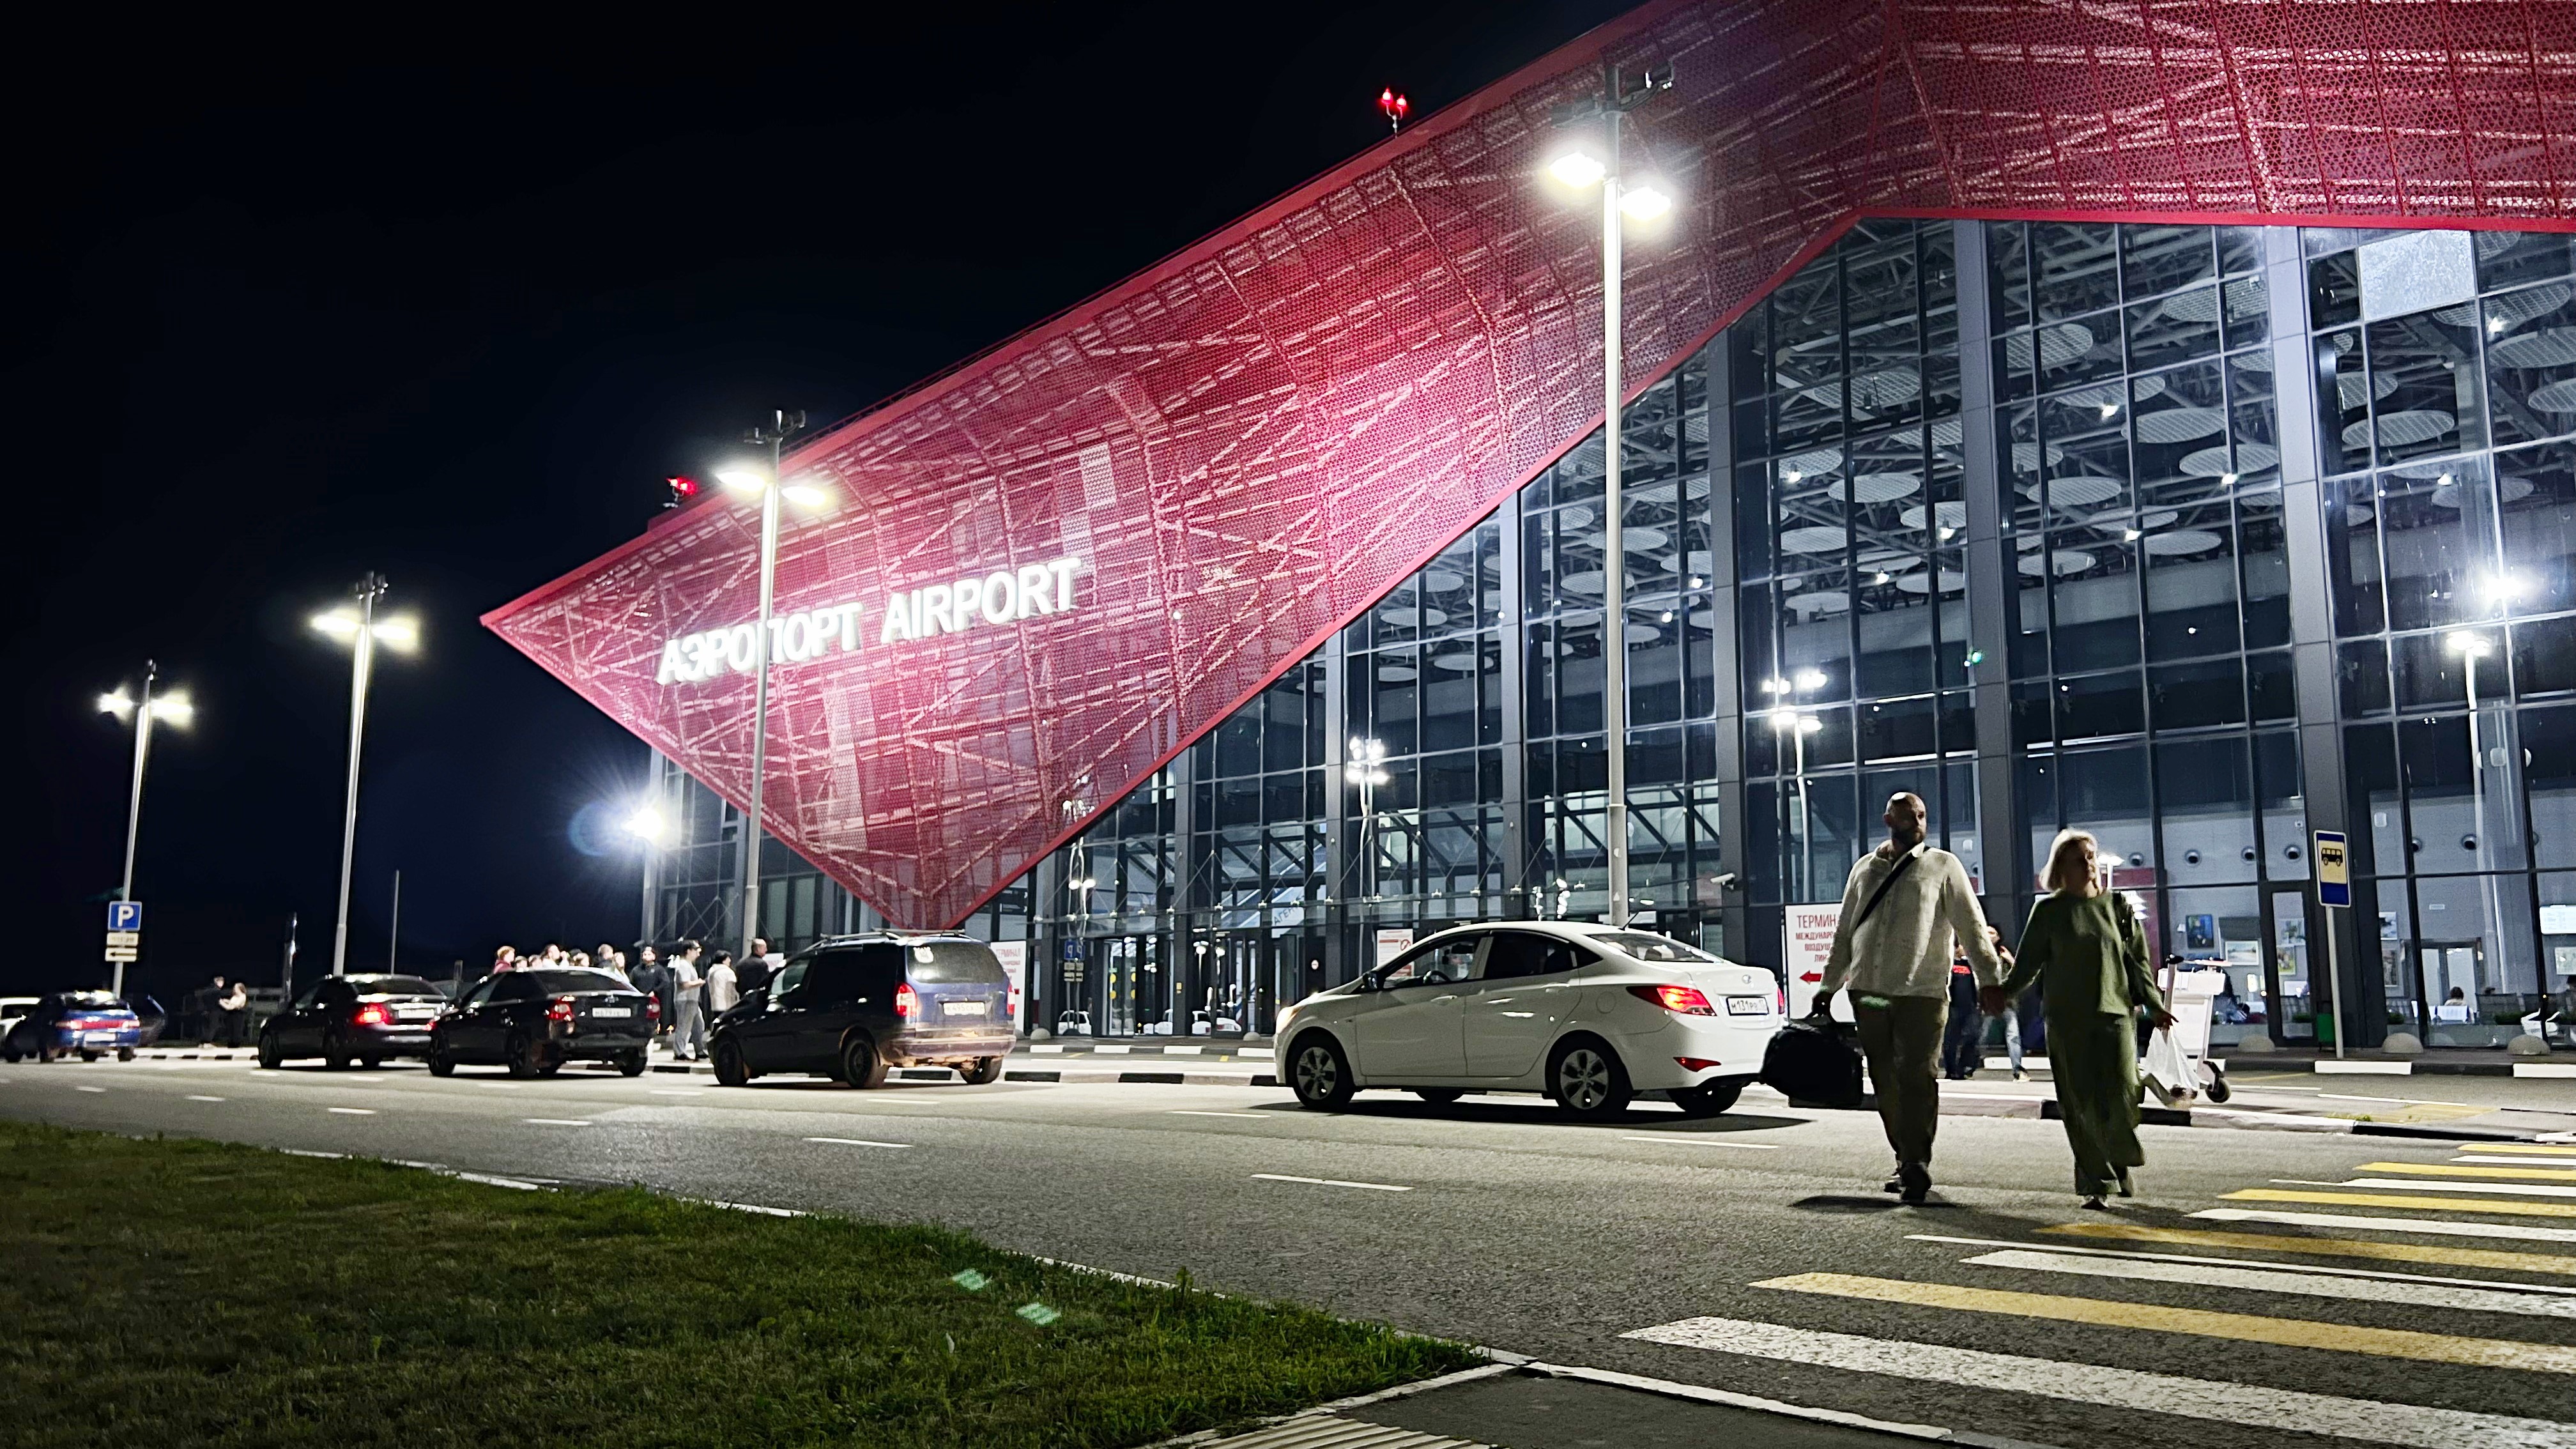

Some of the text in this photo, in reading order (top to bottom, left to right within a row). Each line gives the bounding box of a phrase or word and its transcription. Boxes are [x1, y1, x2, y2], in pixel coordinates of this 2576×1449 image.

[657, 558, 1081, 686] АЭРОПОРТ AIRPORT
[118, 905, 134, 927] P
[1797, 914, 1836, 928] ТЕРМИН
[1804, 943, 1830, 951] ВОЗДУШ
